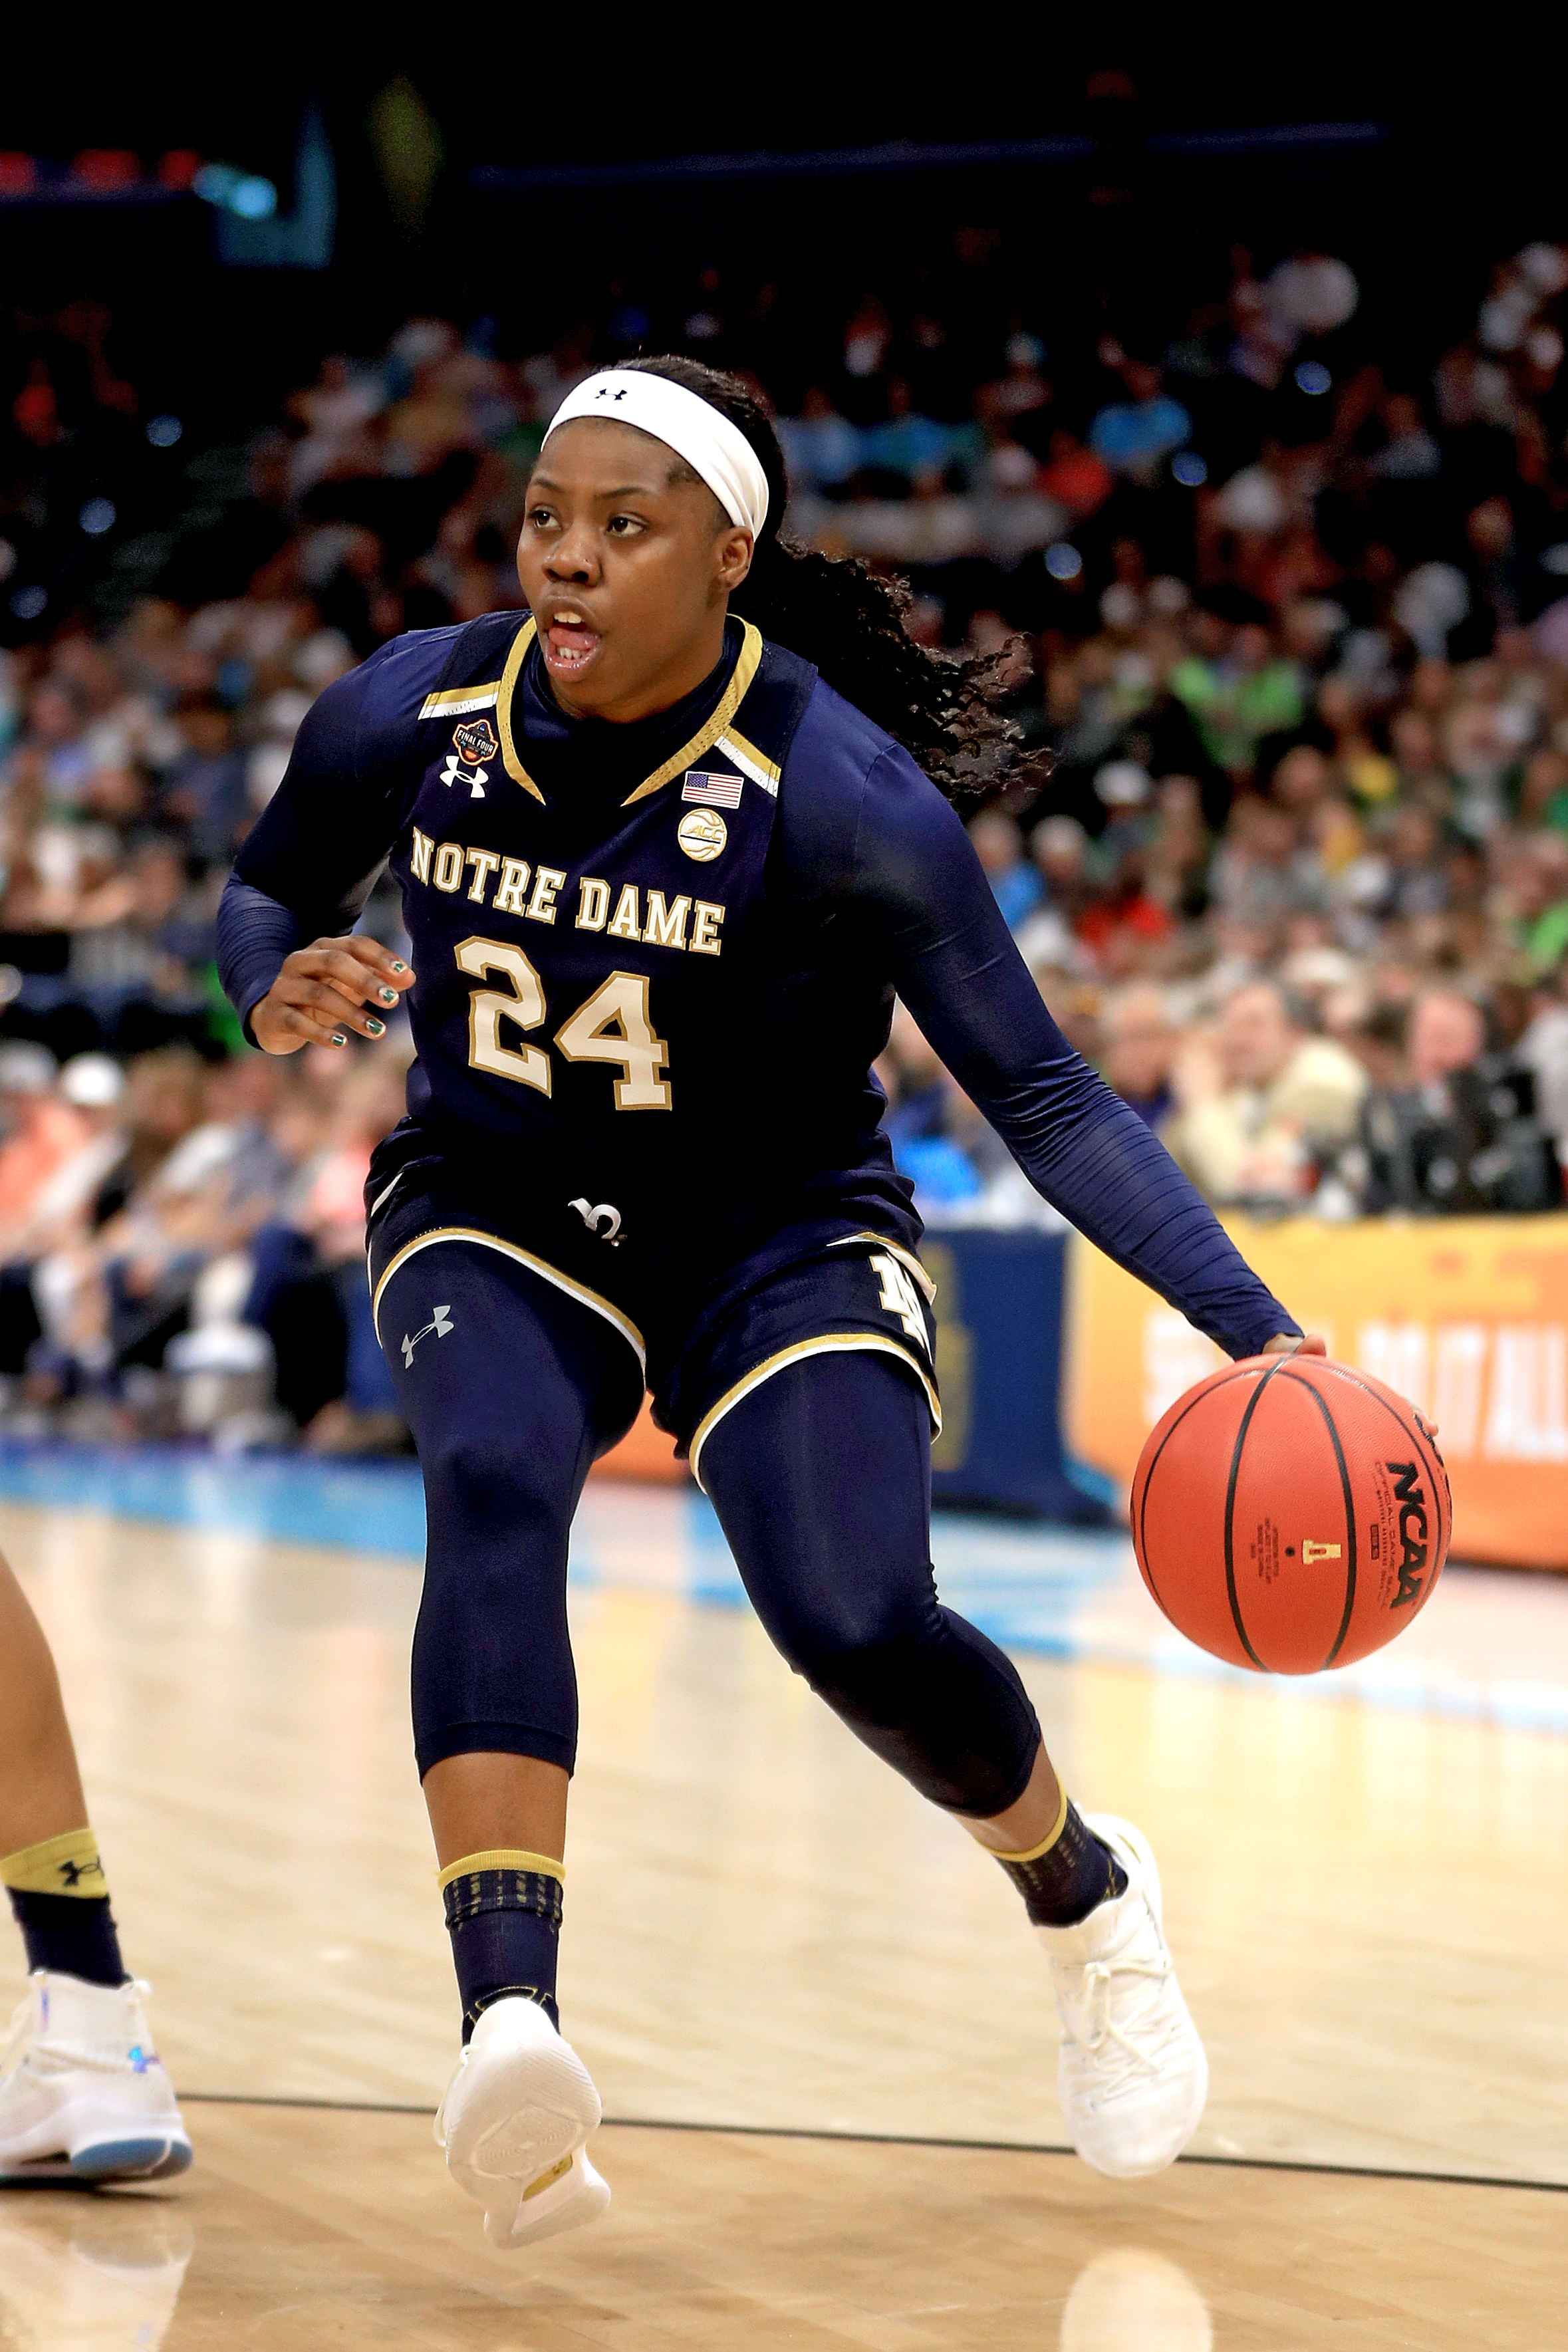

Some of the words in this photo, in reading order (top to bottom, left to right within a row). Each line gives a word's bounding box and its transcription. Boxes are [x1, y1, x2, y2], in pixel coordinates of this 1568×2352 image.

[457, 729, 477, 745] FINAL
[476, 739, 494, 754] FOUR
[410, 826, 567, 925] NOTRE
[575, 876, 726, 956] DAME
[684, 825, 725, 841] ACC
[454, 935, 672, 1111] 24
[1386, 1462, 1428, 1609] NCAA
